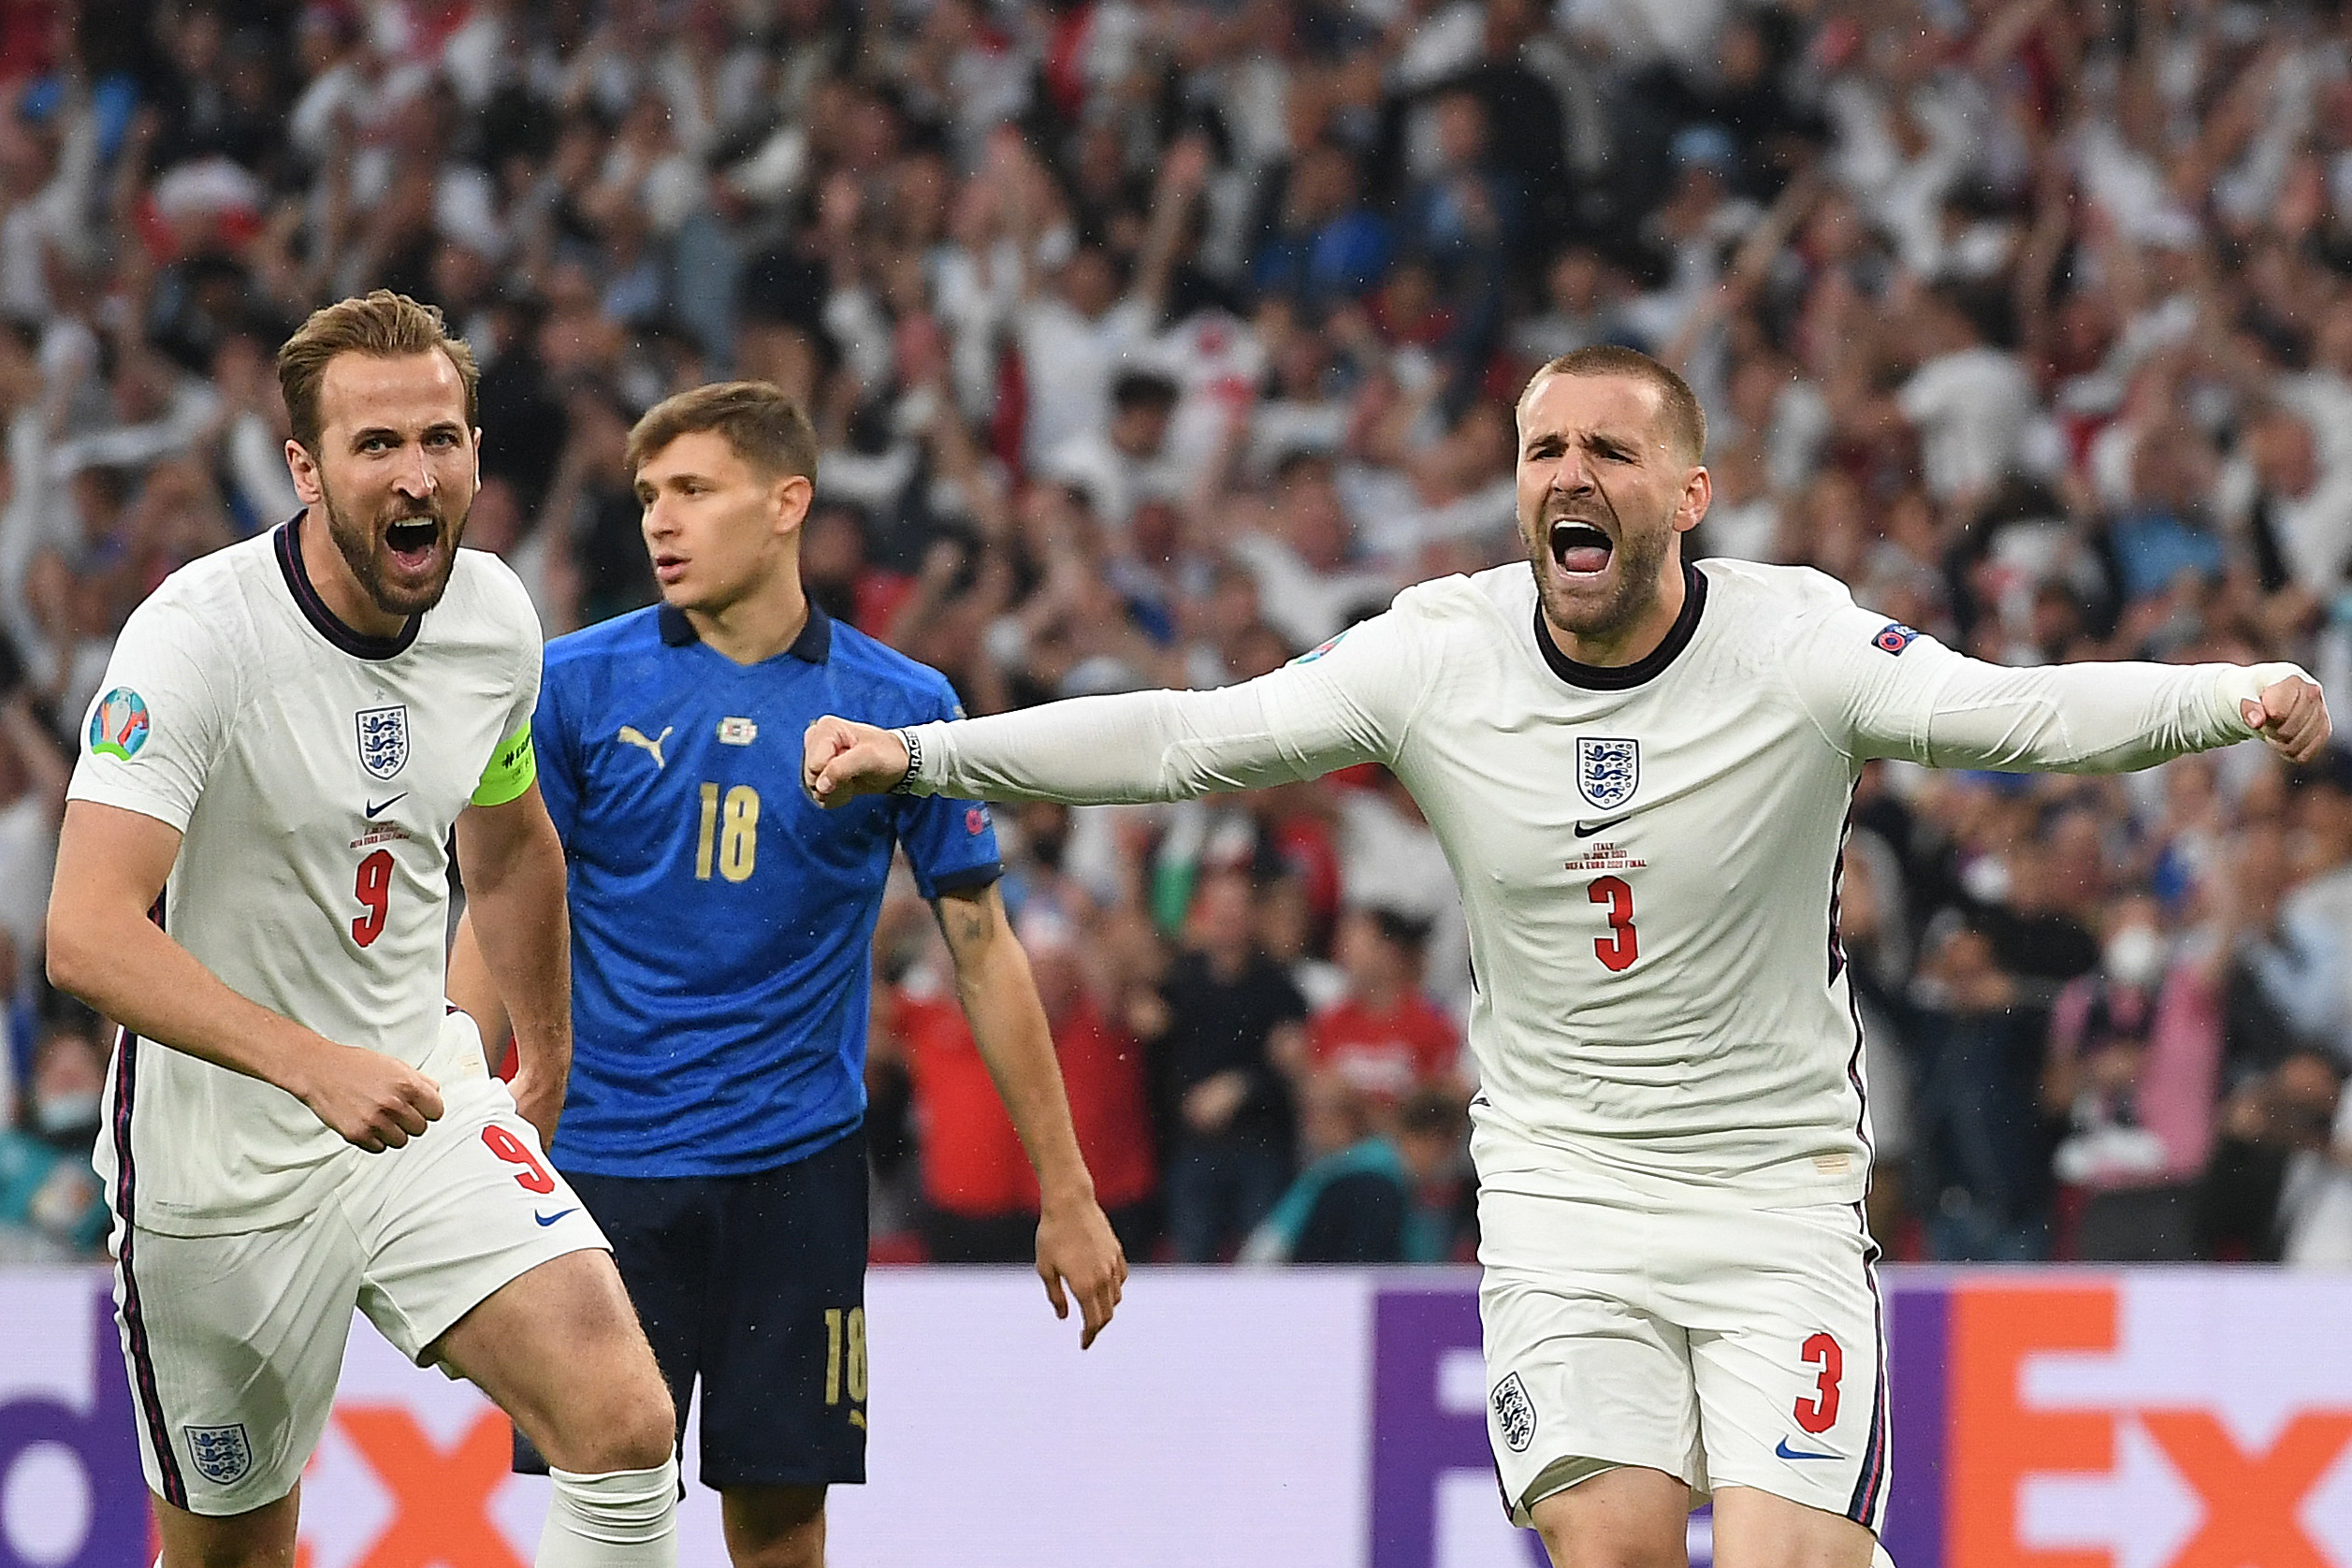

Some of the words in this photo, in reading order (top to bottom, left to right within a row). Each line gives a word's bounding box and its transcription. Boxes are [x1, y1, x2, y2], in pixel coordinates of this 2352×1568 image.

[694, 782, 760, 882] 18
[351, 849, 395, 948] 9
[1588, 875, 1638, 971] 3
[481, 1125, 555, 1194] 9
[825, 1306, 866, 1405] 18
[1793, 1331, 1842, 1433] 3
[1372, 1284, 2352, 1568] FEx
